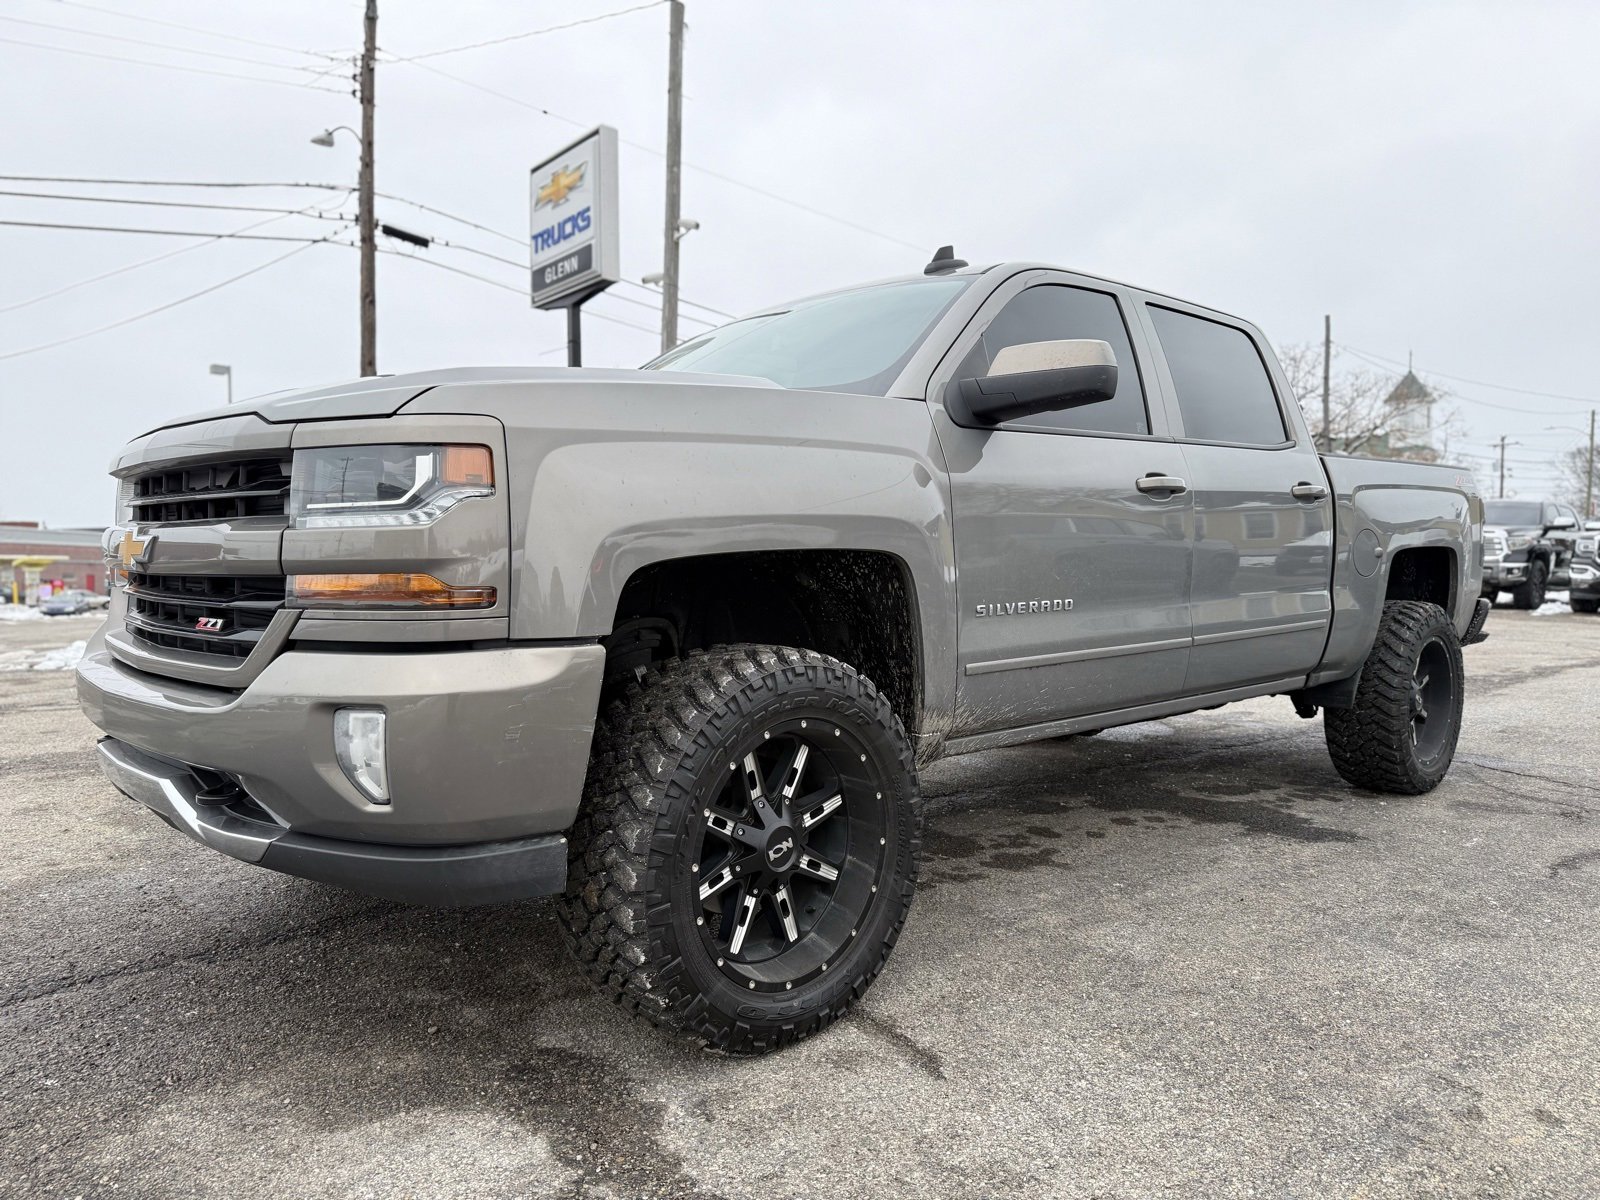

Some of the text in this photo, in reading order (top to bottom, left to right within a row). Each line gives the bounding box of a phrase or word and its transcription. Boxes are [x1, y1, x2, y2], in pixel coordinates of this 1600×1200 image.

[531, 206, 591, 254] TRUCKS
[544, 255, 579, 284] GLENN
[975, 598, 1074, 618] SILVERADO
[195, 616, 224, 632] Z71
